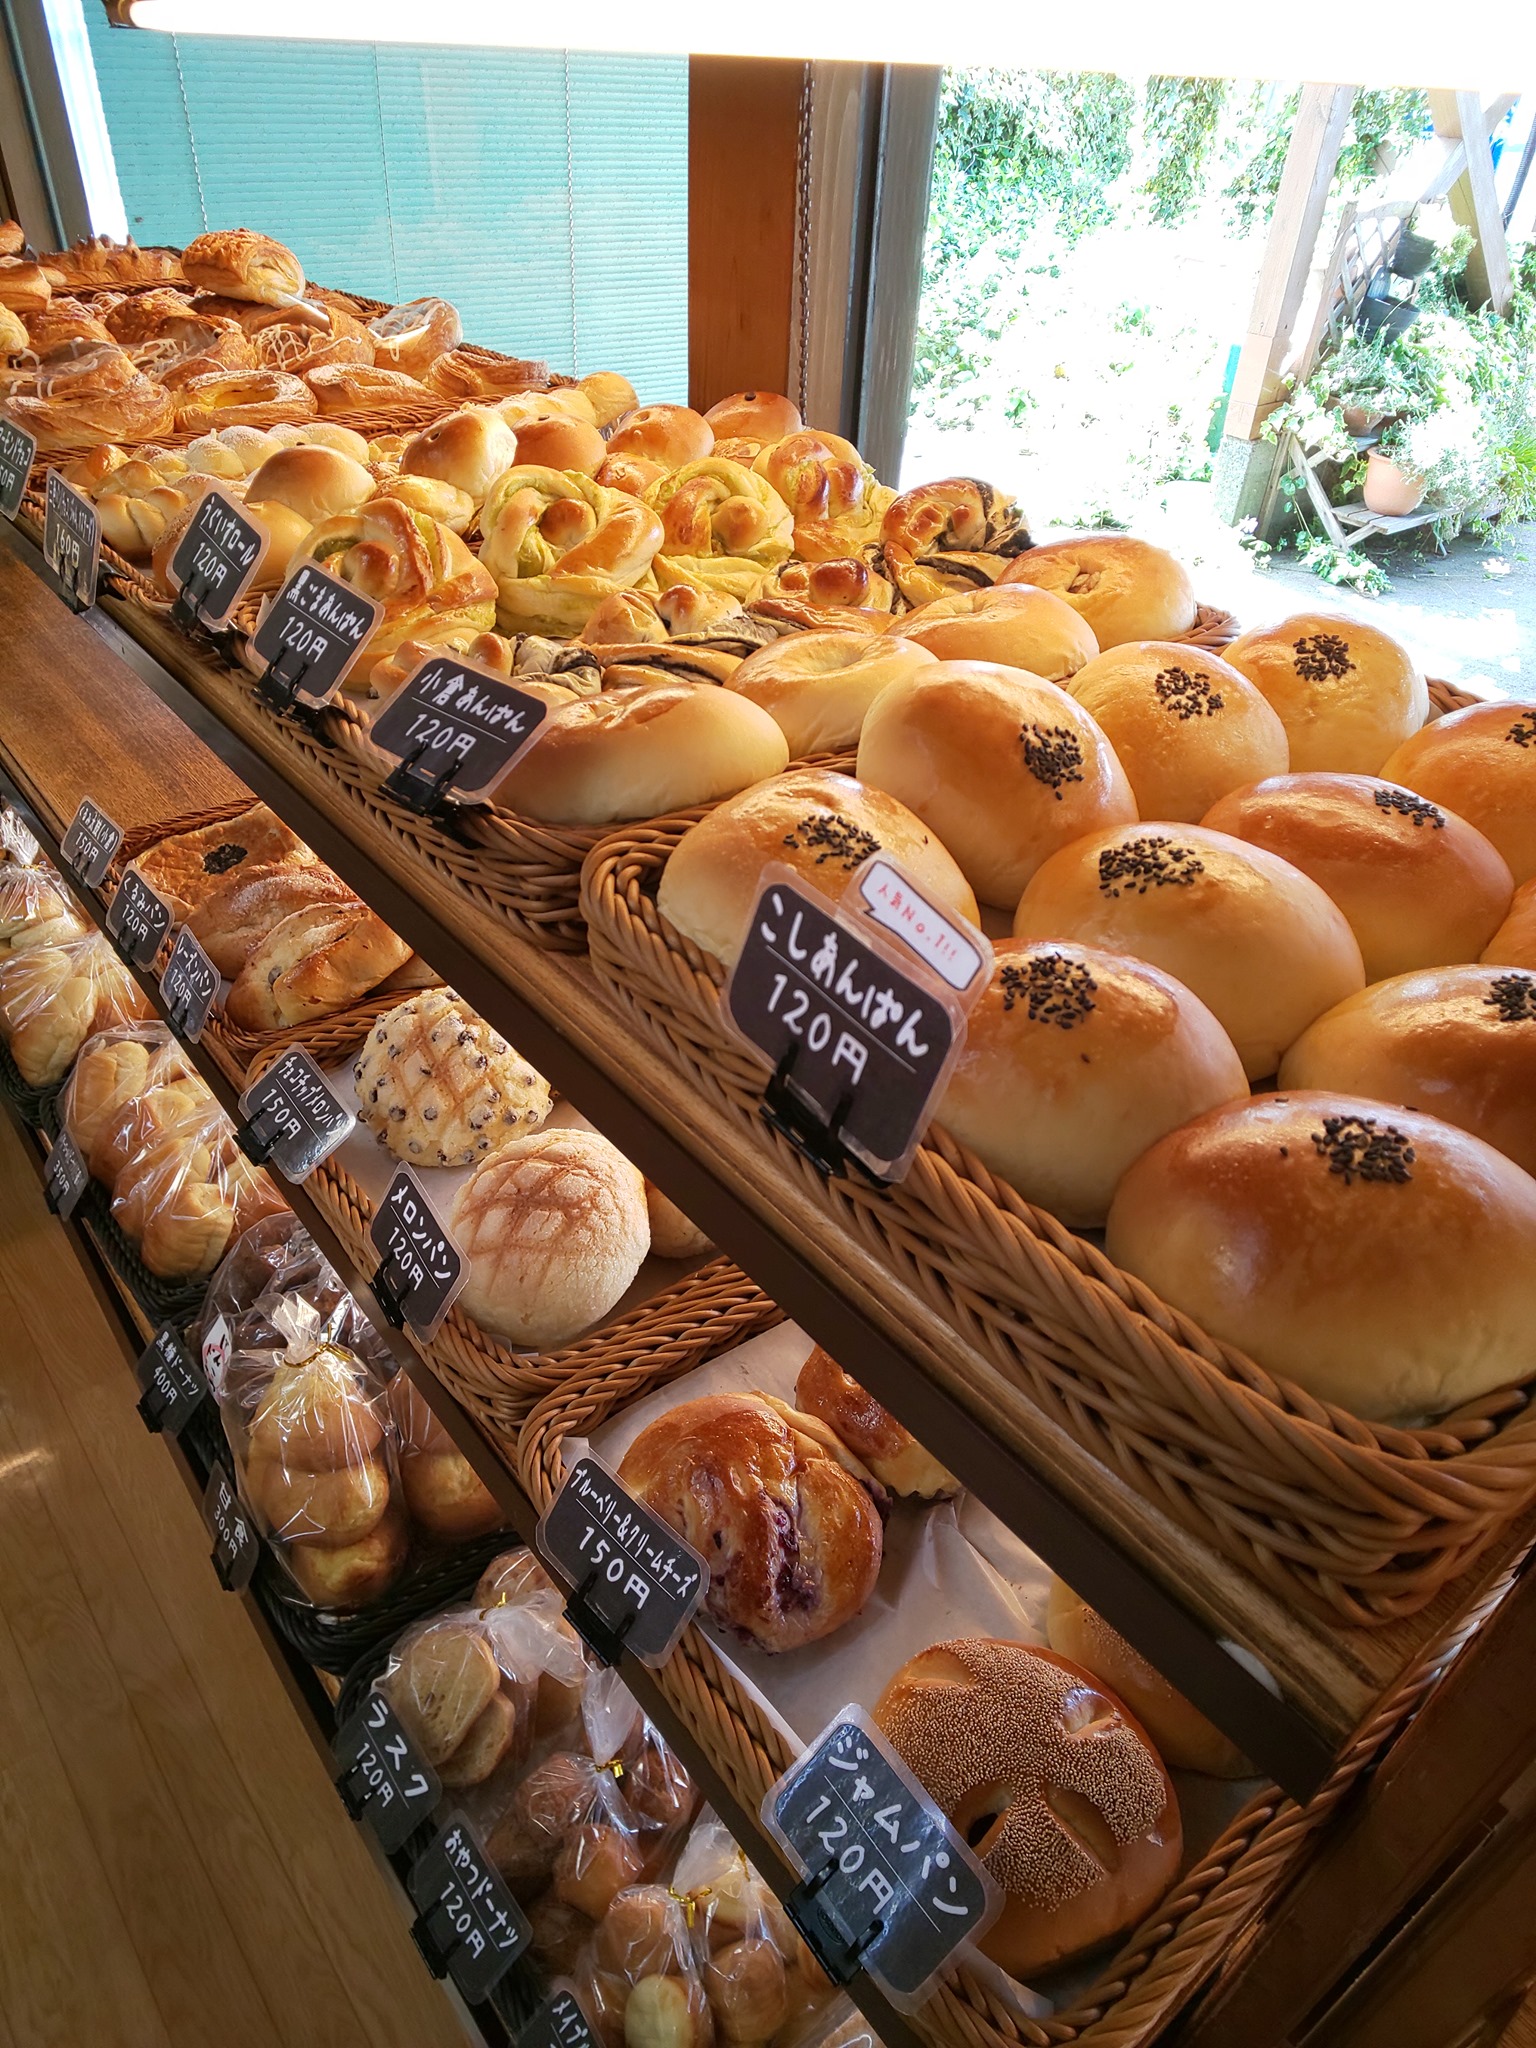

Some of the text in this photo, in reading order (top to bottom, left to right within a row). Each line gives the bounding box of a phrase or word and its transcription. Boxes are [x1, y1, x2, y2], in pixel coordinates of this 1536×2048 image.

[55, 523, 80, 567] 160円
[200, 495, 256, 566] うぐいすロール
[192, 542, 228, 589] 120円
[286, 569, 366, 640] 黒ごまあんぱん
[279, 616, 329, 663] 120円
[420, 667, 526, 733] 小倉あんぱん
[405, 713, 477, 759] 120円
[75, 832, 99, 863] 150円
[121, 903, 149, 942] 120円
[123, 876, 166, 928] くるみパン
[170, 968, 192, 1007] 120円
[176, 935, 212, 998] レーズンパン
[760, 892, 930, 1058] こしあんぱん
[766, 973, 869, 1086] 120円
[261, 1088, 302, 1140] 150円
[278, 1056, 344, 1136] チョコチップメロンパン
[53, 1159, 70, 1196] 350円
[387, 1226, 425, 1291] 120円
[390, 1185, 451, 1280] メロンパン
[153, 1366, 178, 1406] 400円
[155, 1331, 199, 1395] 黒糖ドーナツ
[213, 1504, 238, 1559] 300円
[219, 1480, 249, 1548] 甘食
[569, 1468, 699, 1599] ブルーベリー&クリームチーズ
[579, 1526, 651, 1610] 150円
[355, 1743, 394, 1808] 120円
[367, 1700, 429, 1798] ラスク
[805, 1795, 895, 1915] 120円
[828, 1736, 969, 1916] ジャムパン
[440, 1881, 486, 1959] 120円
[444, 1828, 519, 1949] おやつドーナツ
[551, 1999, 591, 2048] メイプ
